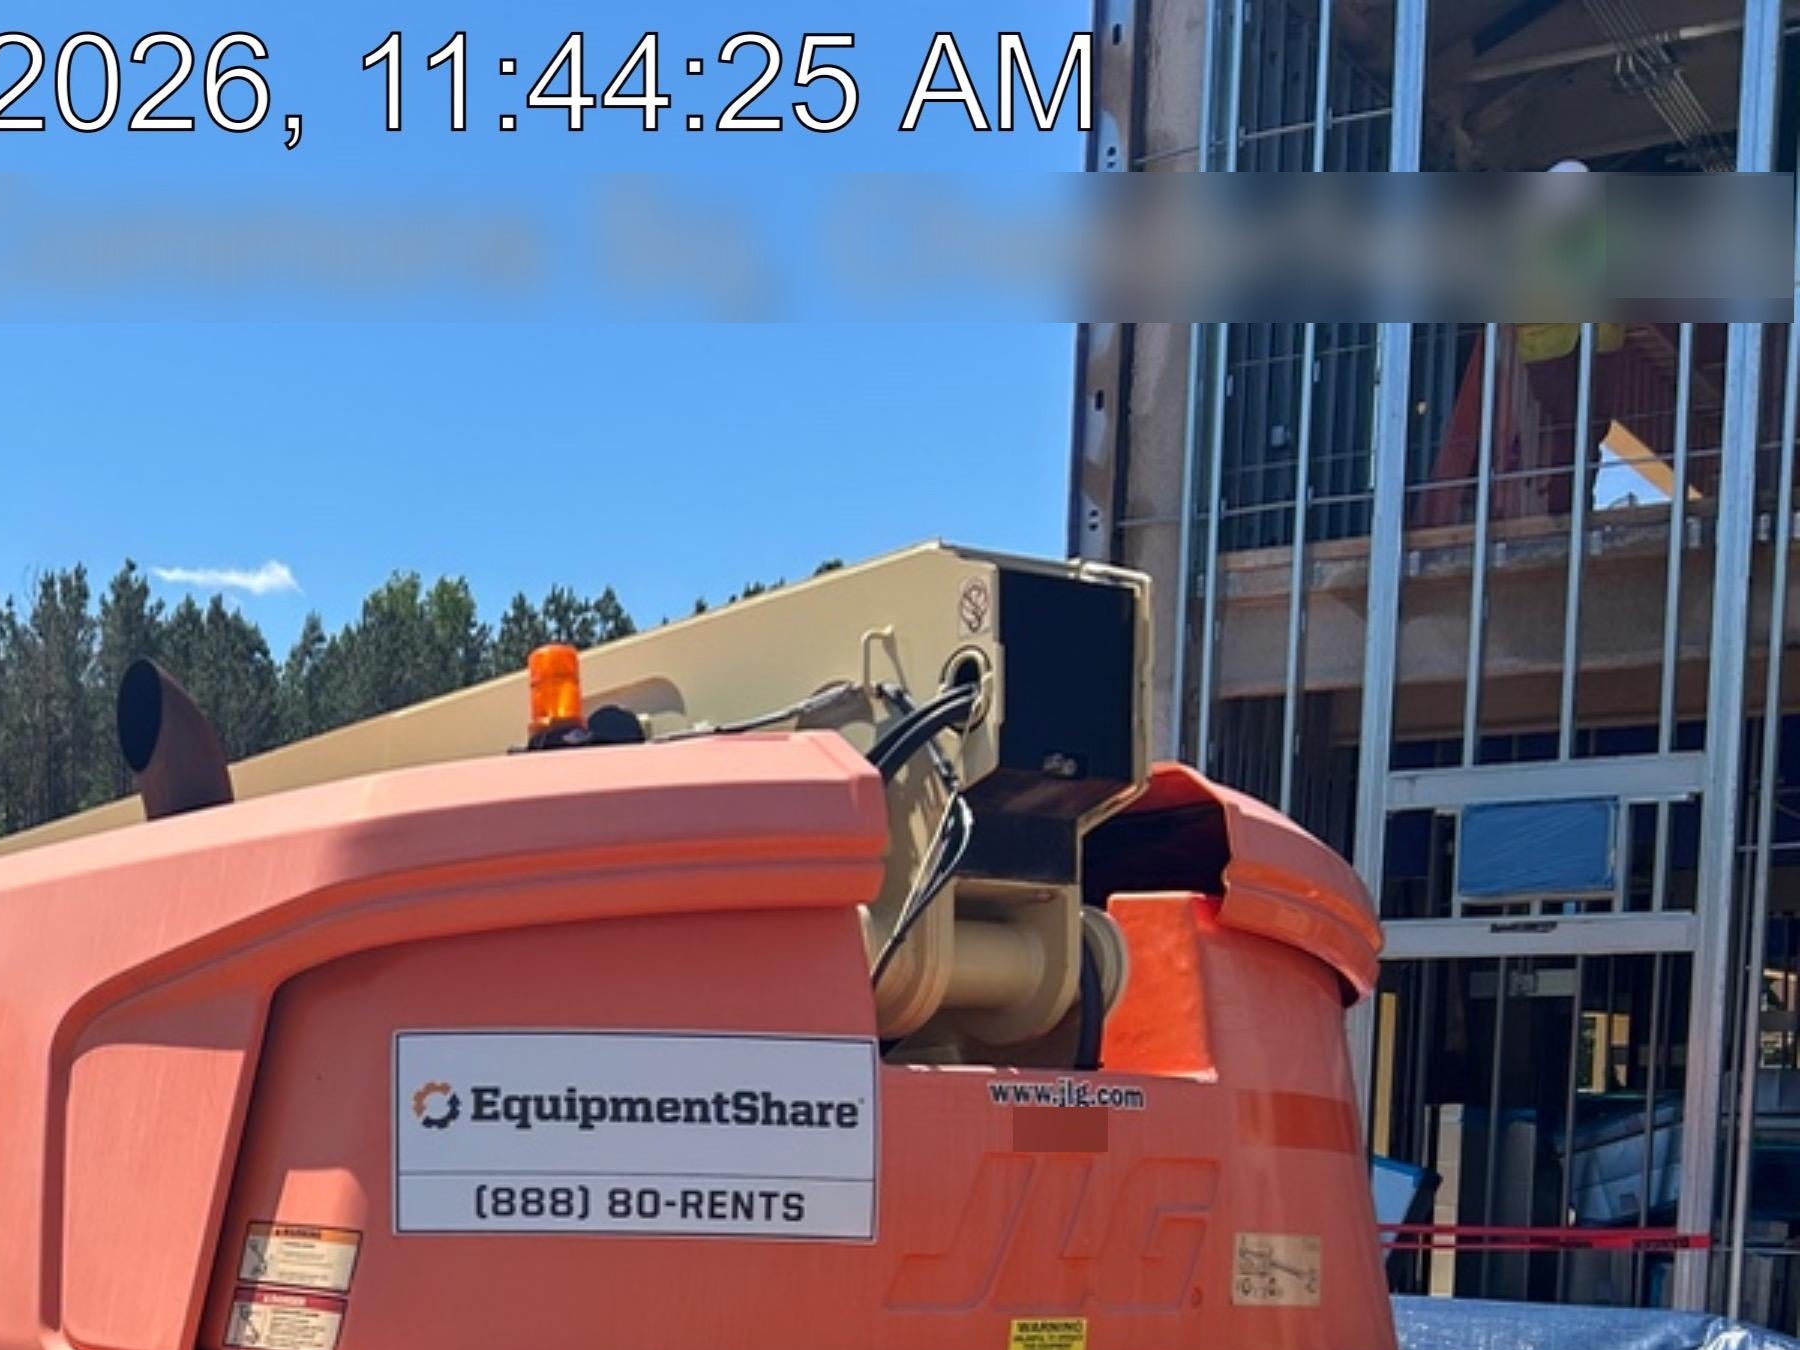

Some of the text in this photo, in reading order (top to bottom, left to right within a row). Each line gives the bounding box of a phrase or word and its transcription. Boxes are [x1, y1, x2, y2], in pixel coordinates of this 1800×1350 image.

[470, 1087, 860, 1130] EquipmentShare
[990, 1079, 1144, 1109] www.jlg.com
[474, 1185, 806, 1222] (888) 80-RENTS
